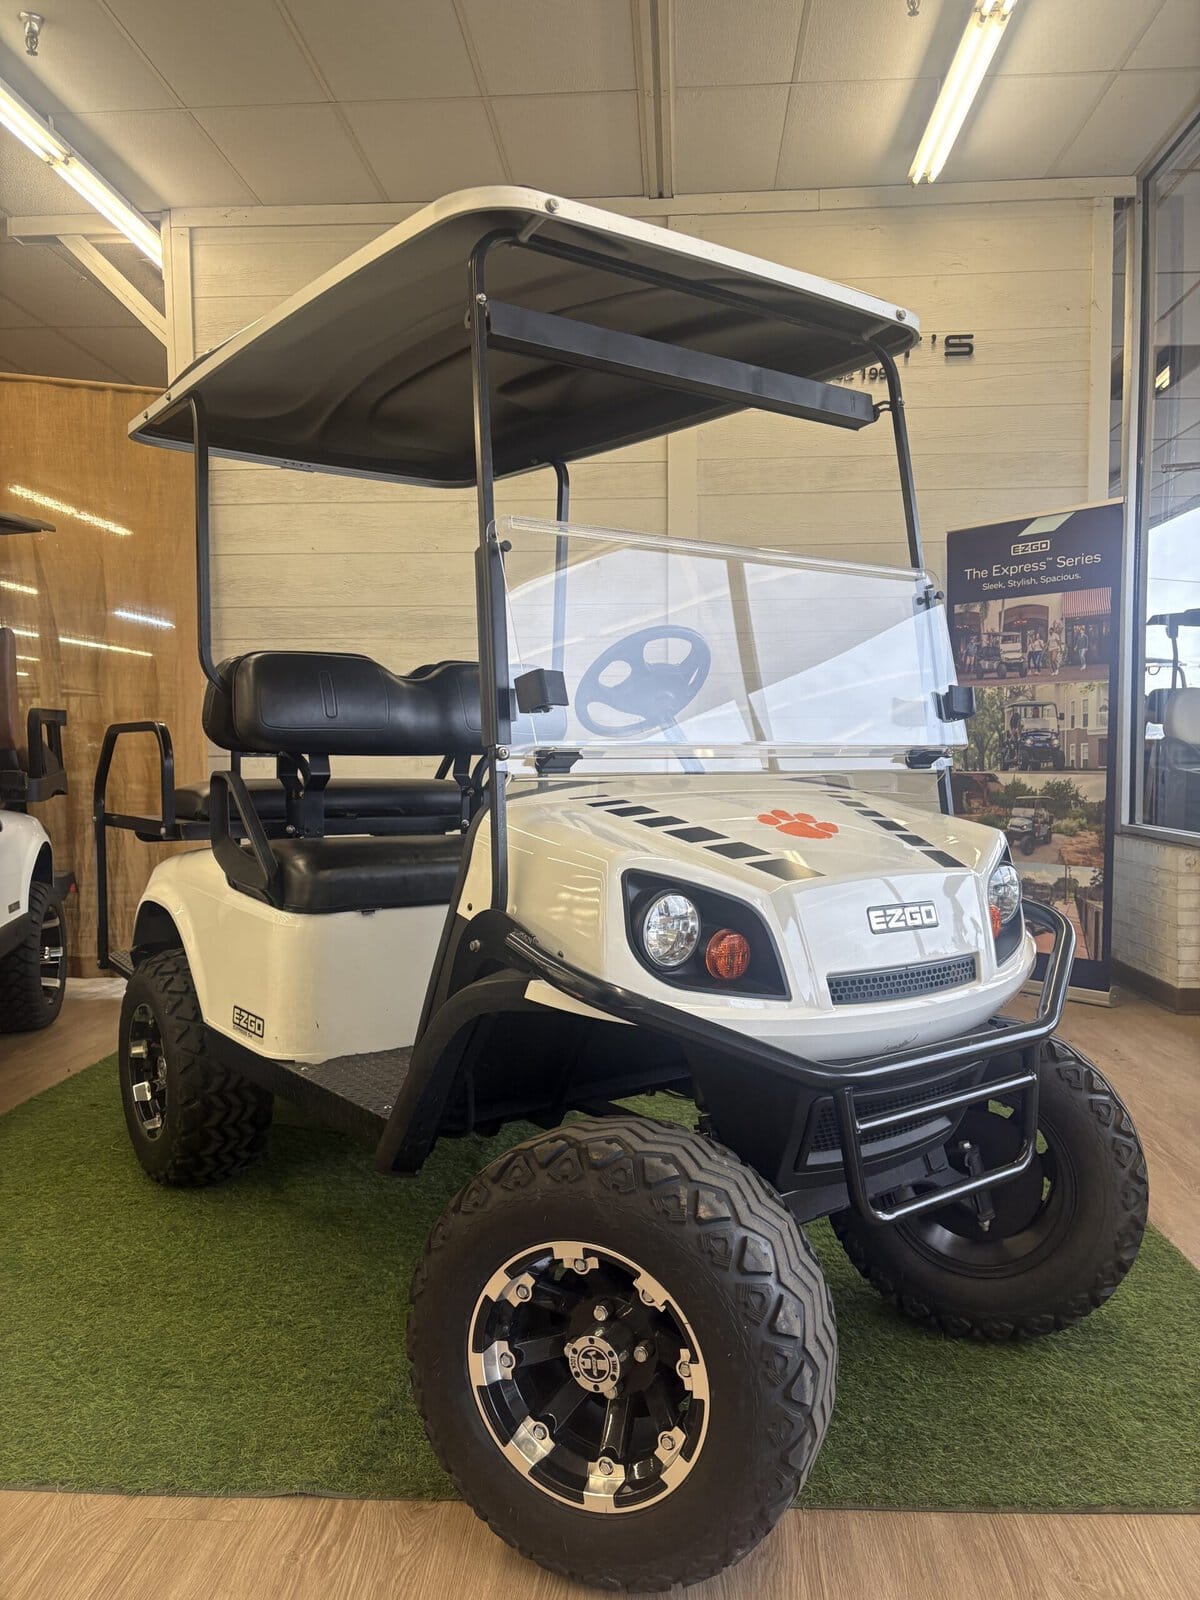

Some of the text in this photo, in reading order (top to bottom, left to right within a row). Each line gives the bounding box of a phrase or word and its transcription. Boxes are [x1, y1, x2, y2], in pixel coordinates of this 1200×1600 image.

[1012, 541, 1049, 555] EZGO
[964, 567, 989, 580] The
[1056, 553, 1102, 568] Series
[868, 904, 936, 930] EZGO
[233, 1007, 264, 1037] EZGO
